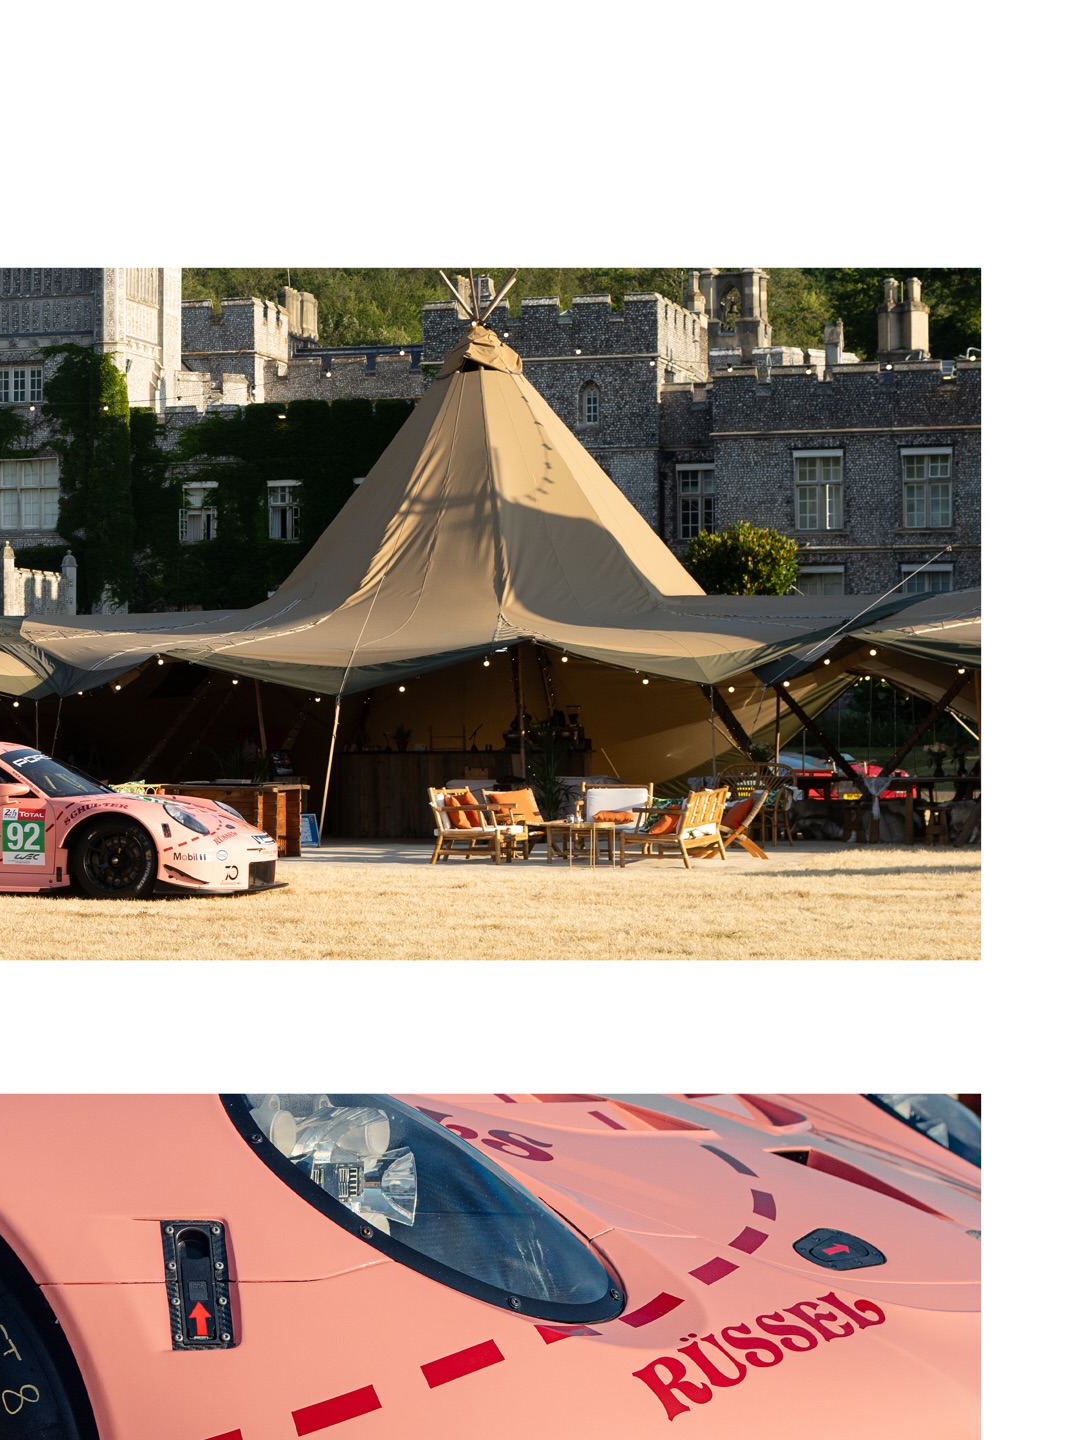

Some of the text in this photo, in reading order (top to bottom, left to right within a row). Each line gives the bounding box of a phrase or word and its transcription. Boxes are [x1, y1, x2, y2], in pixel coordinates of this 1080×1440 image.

[7, 822, 40, 850] 92
[173, 852, 198, 861] Mobil
[225, 865, 239, 880] 70
[632, 1291, 886, 1422] RÜSSEL
[2, 1384, 40, 1415] 8
